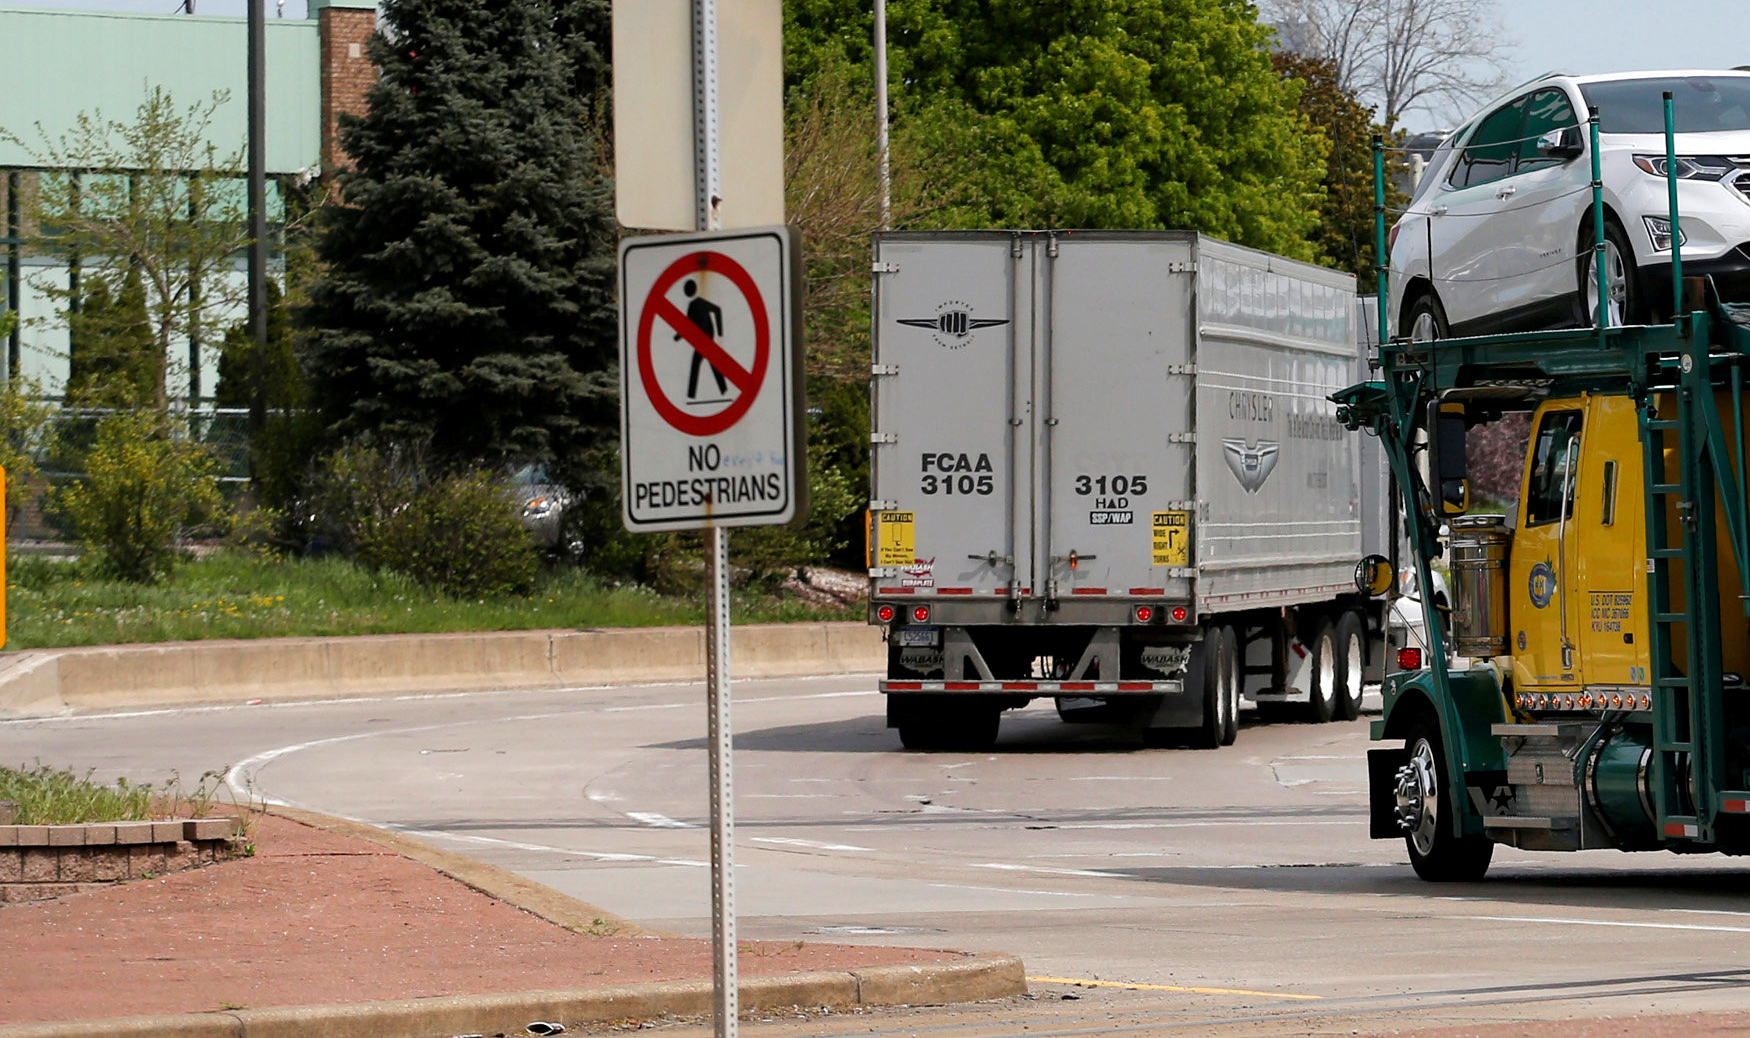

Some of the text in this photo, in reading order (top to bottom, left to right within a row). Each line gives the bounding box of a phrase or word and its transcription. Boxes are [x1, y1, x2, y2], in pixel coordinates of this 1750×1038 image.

[1229, 391, 1273, 422] CHRYSLER
[689, 443, 721, 472] NO
[922, 453, 993, 473] FCAA
[635, 472, 781, 509] PEDESTRIANS
[921, 475, 994, 495] 3105
[1075, 475, 1148, 496] 3105
[882, 513, 913, 522] CAUTION
[1091, 512, 1132, 524] SSP/WAP
[1154, 515, 1184, 524] CAUTION
[1153, 529, 1166, 537] WIDE
[1153, 542, 1168, 550] RIGHT
[1153, 555, 1169, 563] TURNS
[1142, 654, 1189, 664] WABASH
